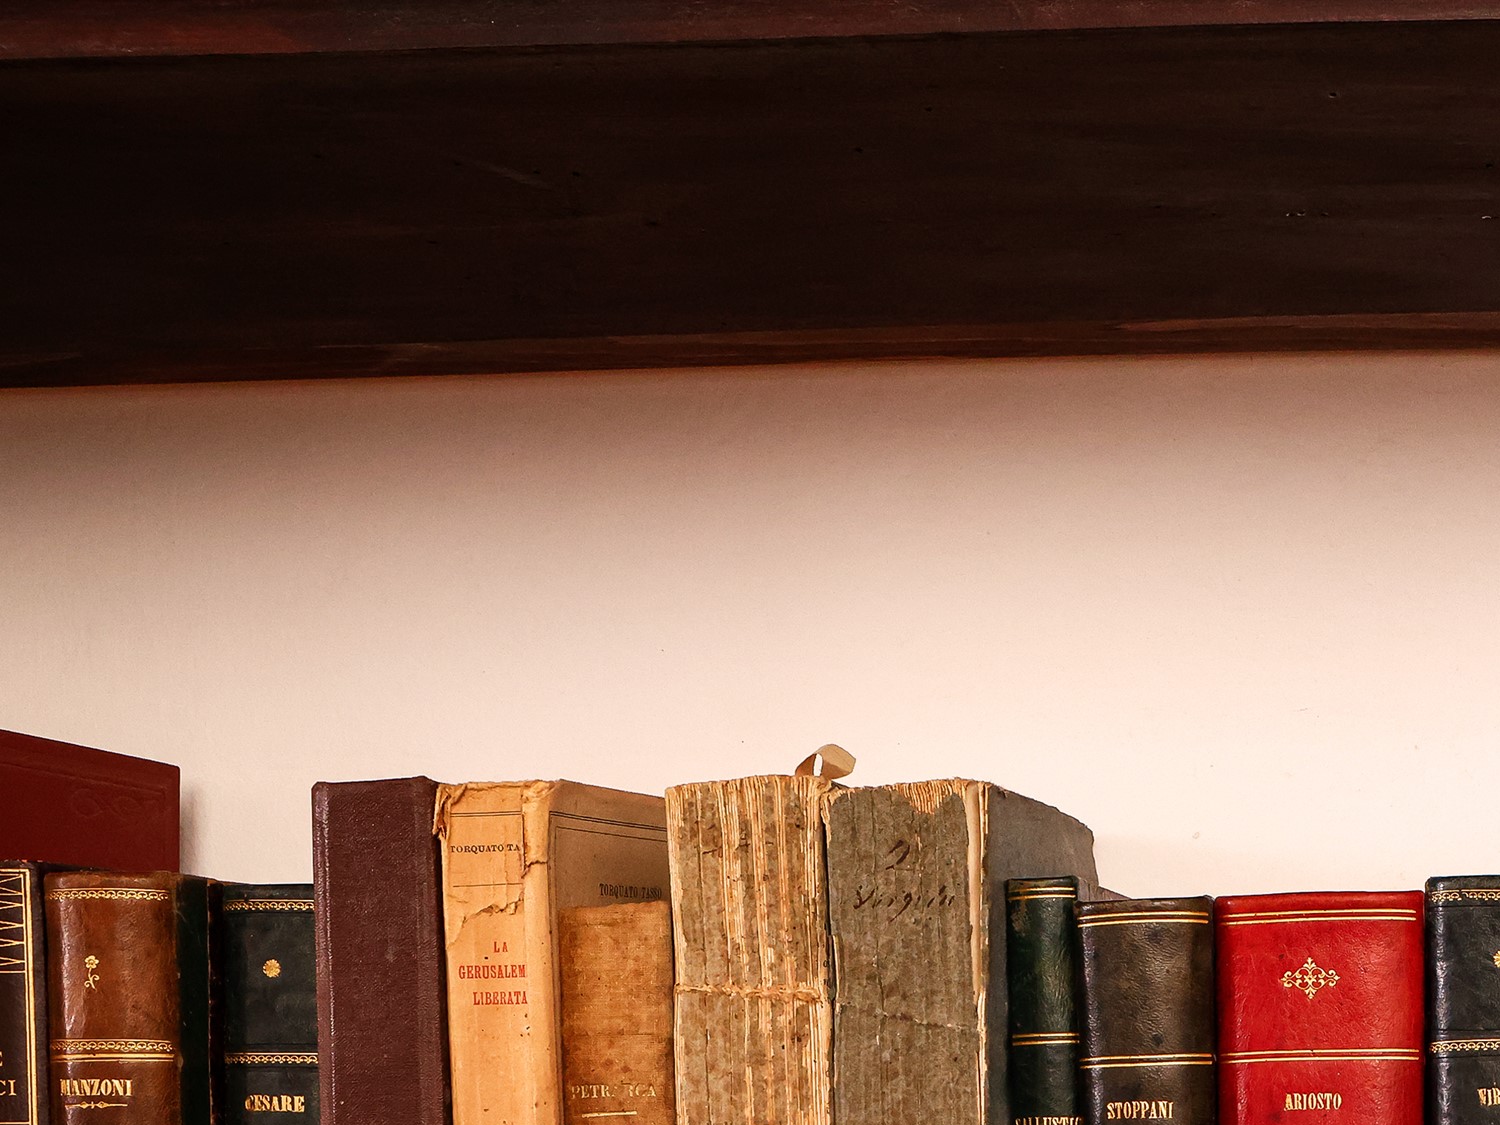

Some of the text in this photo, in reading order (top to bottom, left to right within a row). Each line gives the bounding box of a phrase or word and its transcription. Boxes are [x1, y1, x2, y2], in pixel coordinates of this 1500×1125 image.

[450, 844, 504, 853] TORQUATO
[599, 883, 662, 899] TORQUATO TASSO
[493, 941, 508, 953] LA
[458, 964, 526, 980] GERUSALEM
[473, 991, 528, 1006] LIBERATA
[60, 1079, 133, 1096] MANZONI
[571, 1083, 656, 1099] PETRRCA
[245, 1094, 305, 1113] CESARE
[1284, 1092, 1342, 1110] ARIOSTO
[1107, 1100, 1174, 1120] STOPPANI
